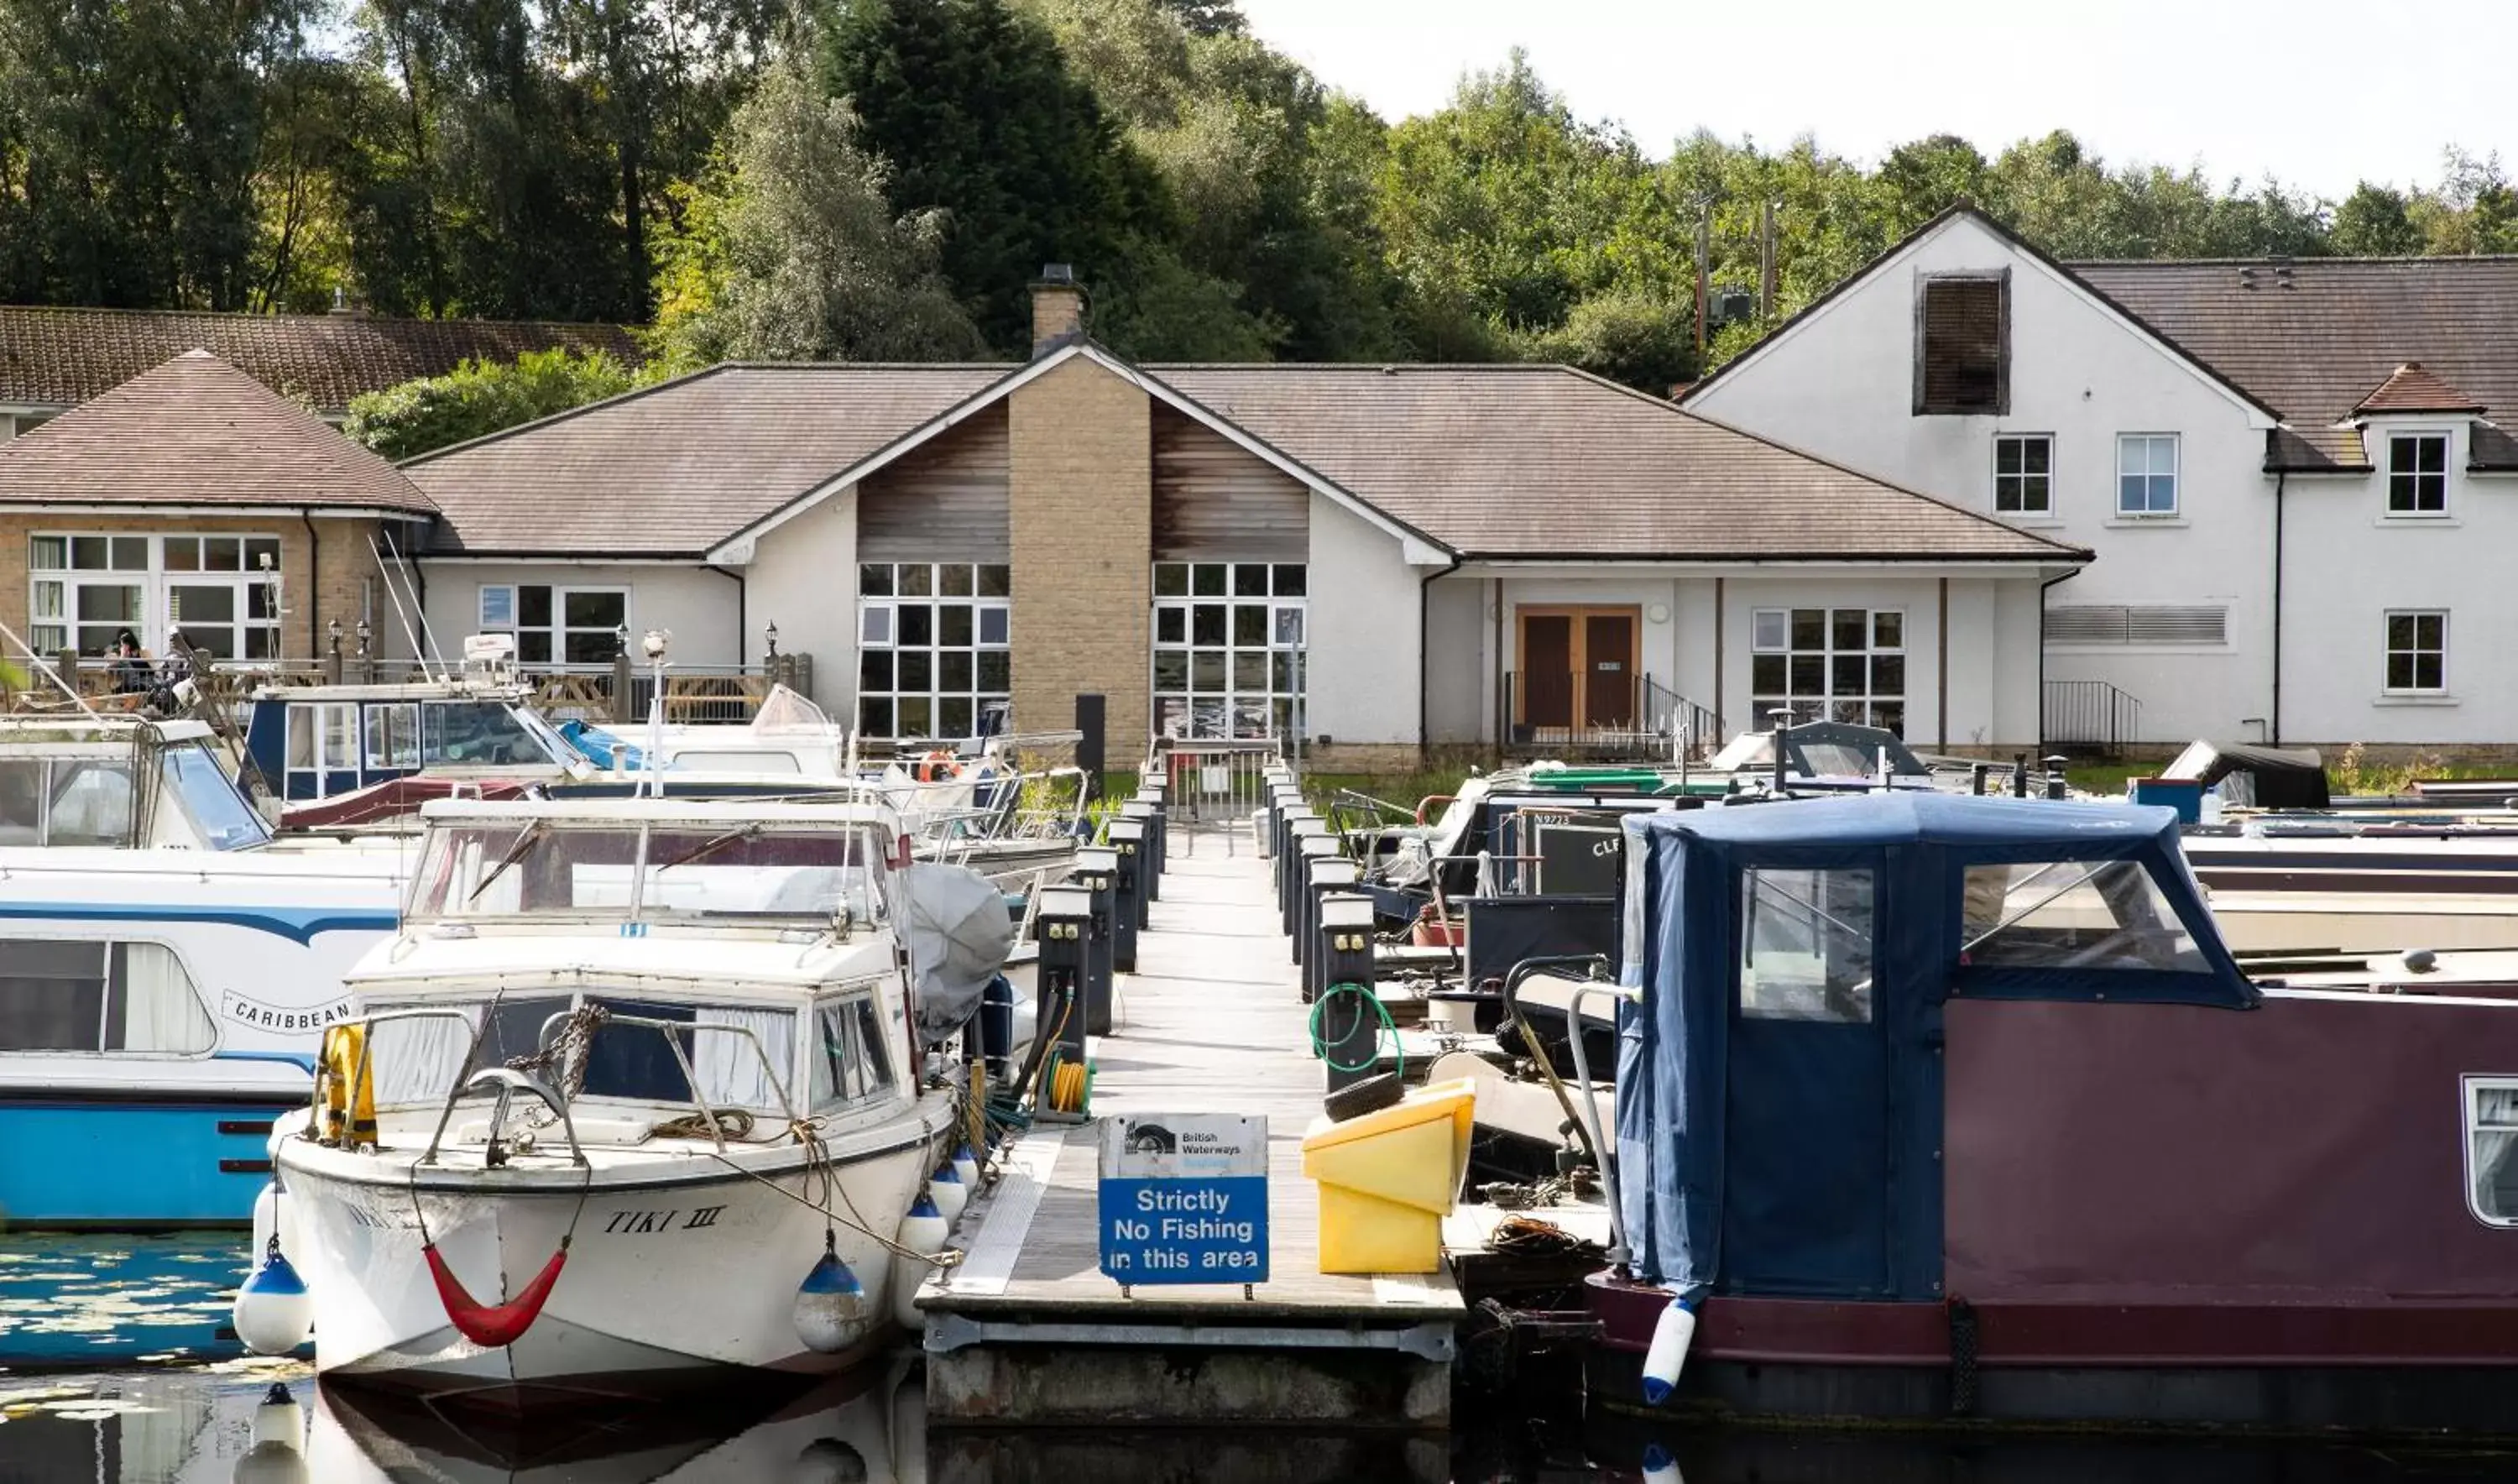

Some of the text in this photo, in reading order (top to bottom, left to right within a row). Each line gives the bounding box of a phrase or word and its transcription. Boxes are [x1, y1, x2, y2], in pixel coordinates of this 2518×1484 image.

[235, 1001, 350, 1029] CARIBBEAN
[1182, 1132, 1219, 1142] British
[1182, 1145, 1241, 1156] Waterways
[1136, 1189, 1230, 1215] Strictly
[604, 1204, 729, 1233] TIKI III
[1115, 1218, 1253, 1243] No Fishing
[1110, 1248, 1259, 1270] in this area
